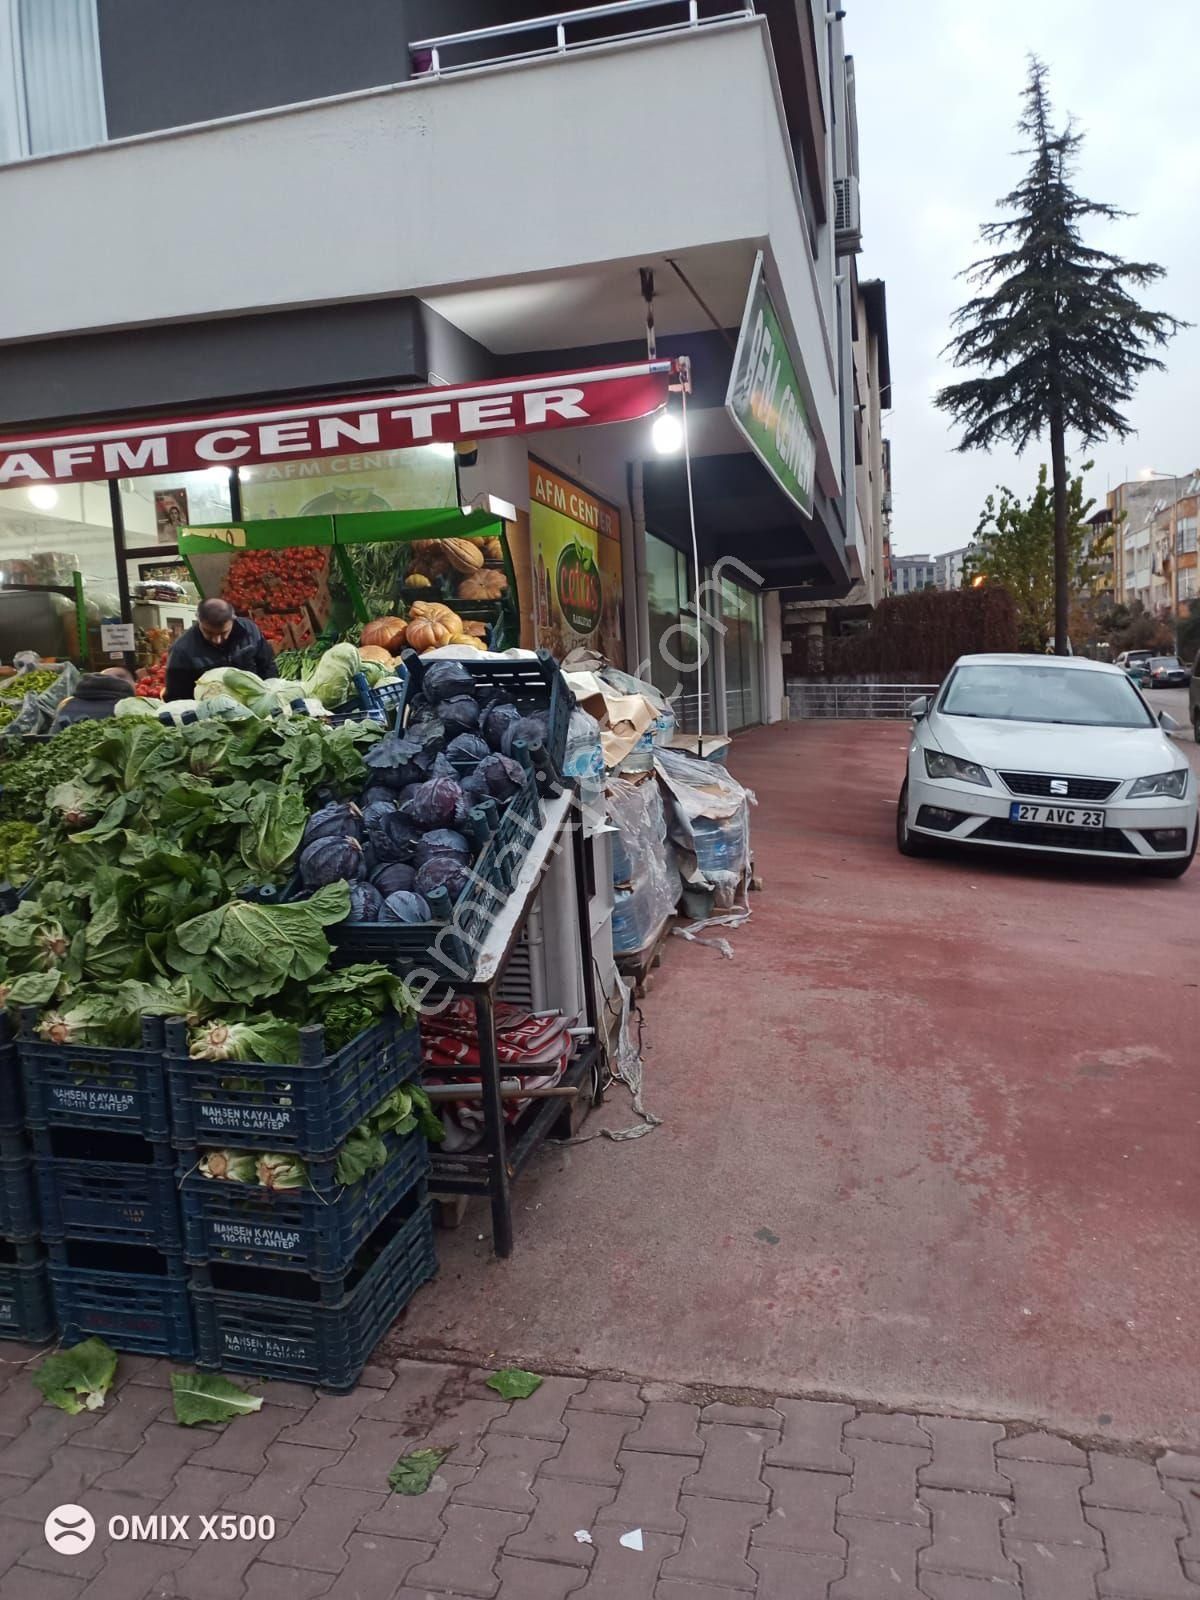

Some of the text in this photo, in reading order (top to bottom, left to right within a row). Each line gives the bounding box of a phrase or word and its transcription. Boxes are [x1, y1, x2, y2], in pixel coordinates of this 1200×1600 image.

[0, 388, 590, 484] AFM CENTER
[535, 474, 612, 535] AFM CENTER
[1020, 807, 1039, 821] 27
[1045, 809, 1075, 824] AVC
[1082, 812, 1102, 826] 23
[89, 1092, 134, 1104] KAYALAR
[201, 1105, 290, 1122] NAHSEN KAYALAR
[213, 1223, 300, 1243] NAHSEN KAYALAR
